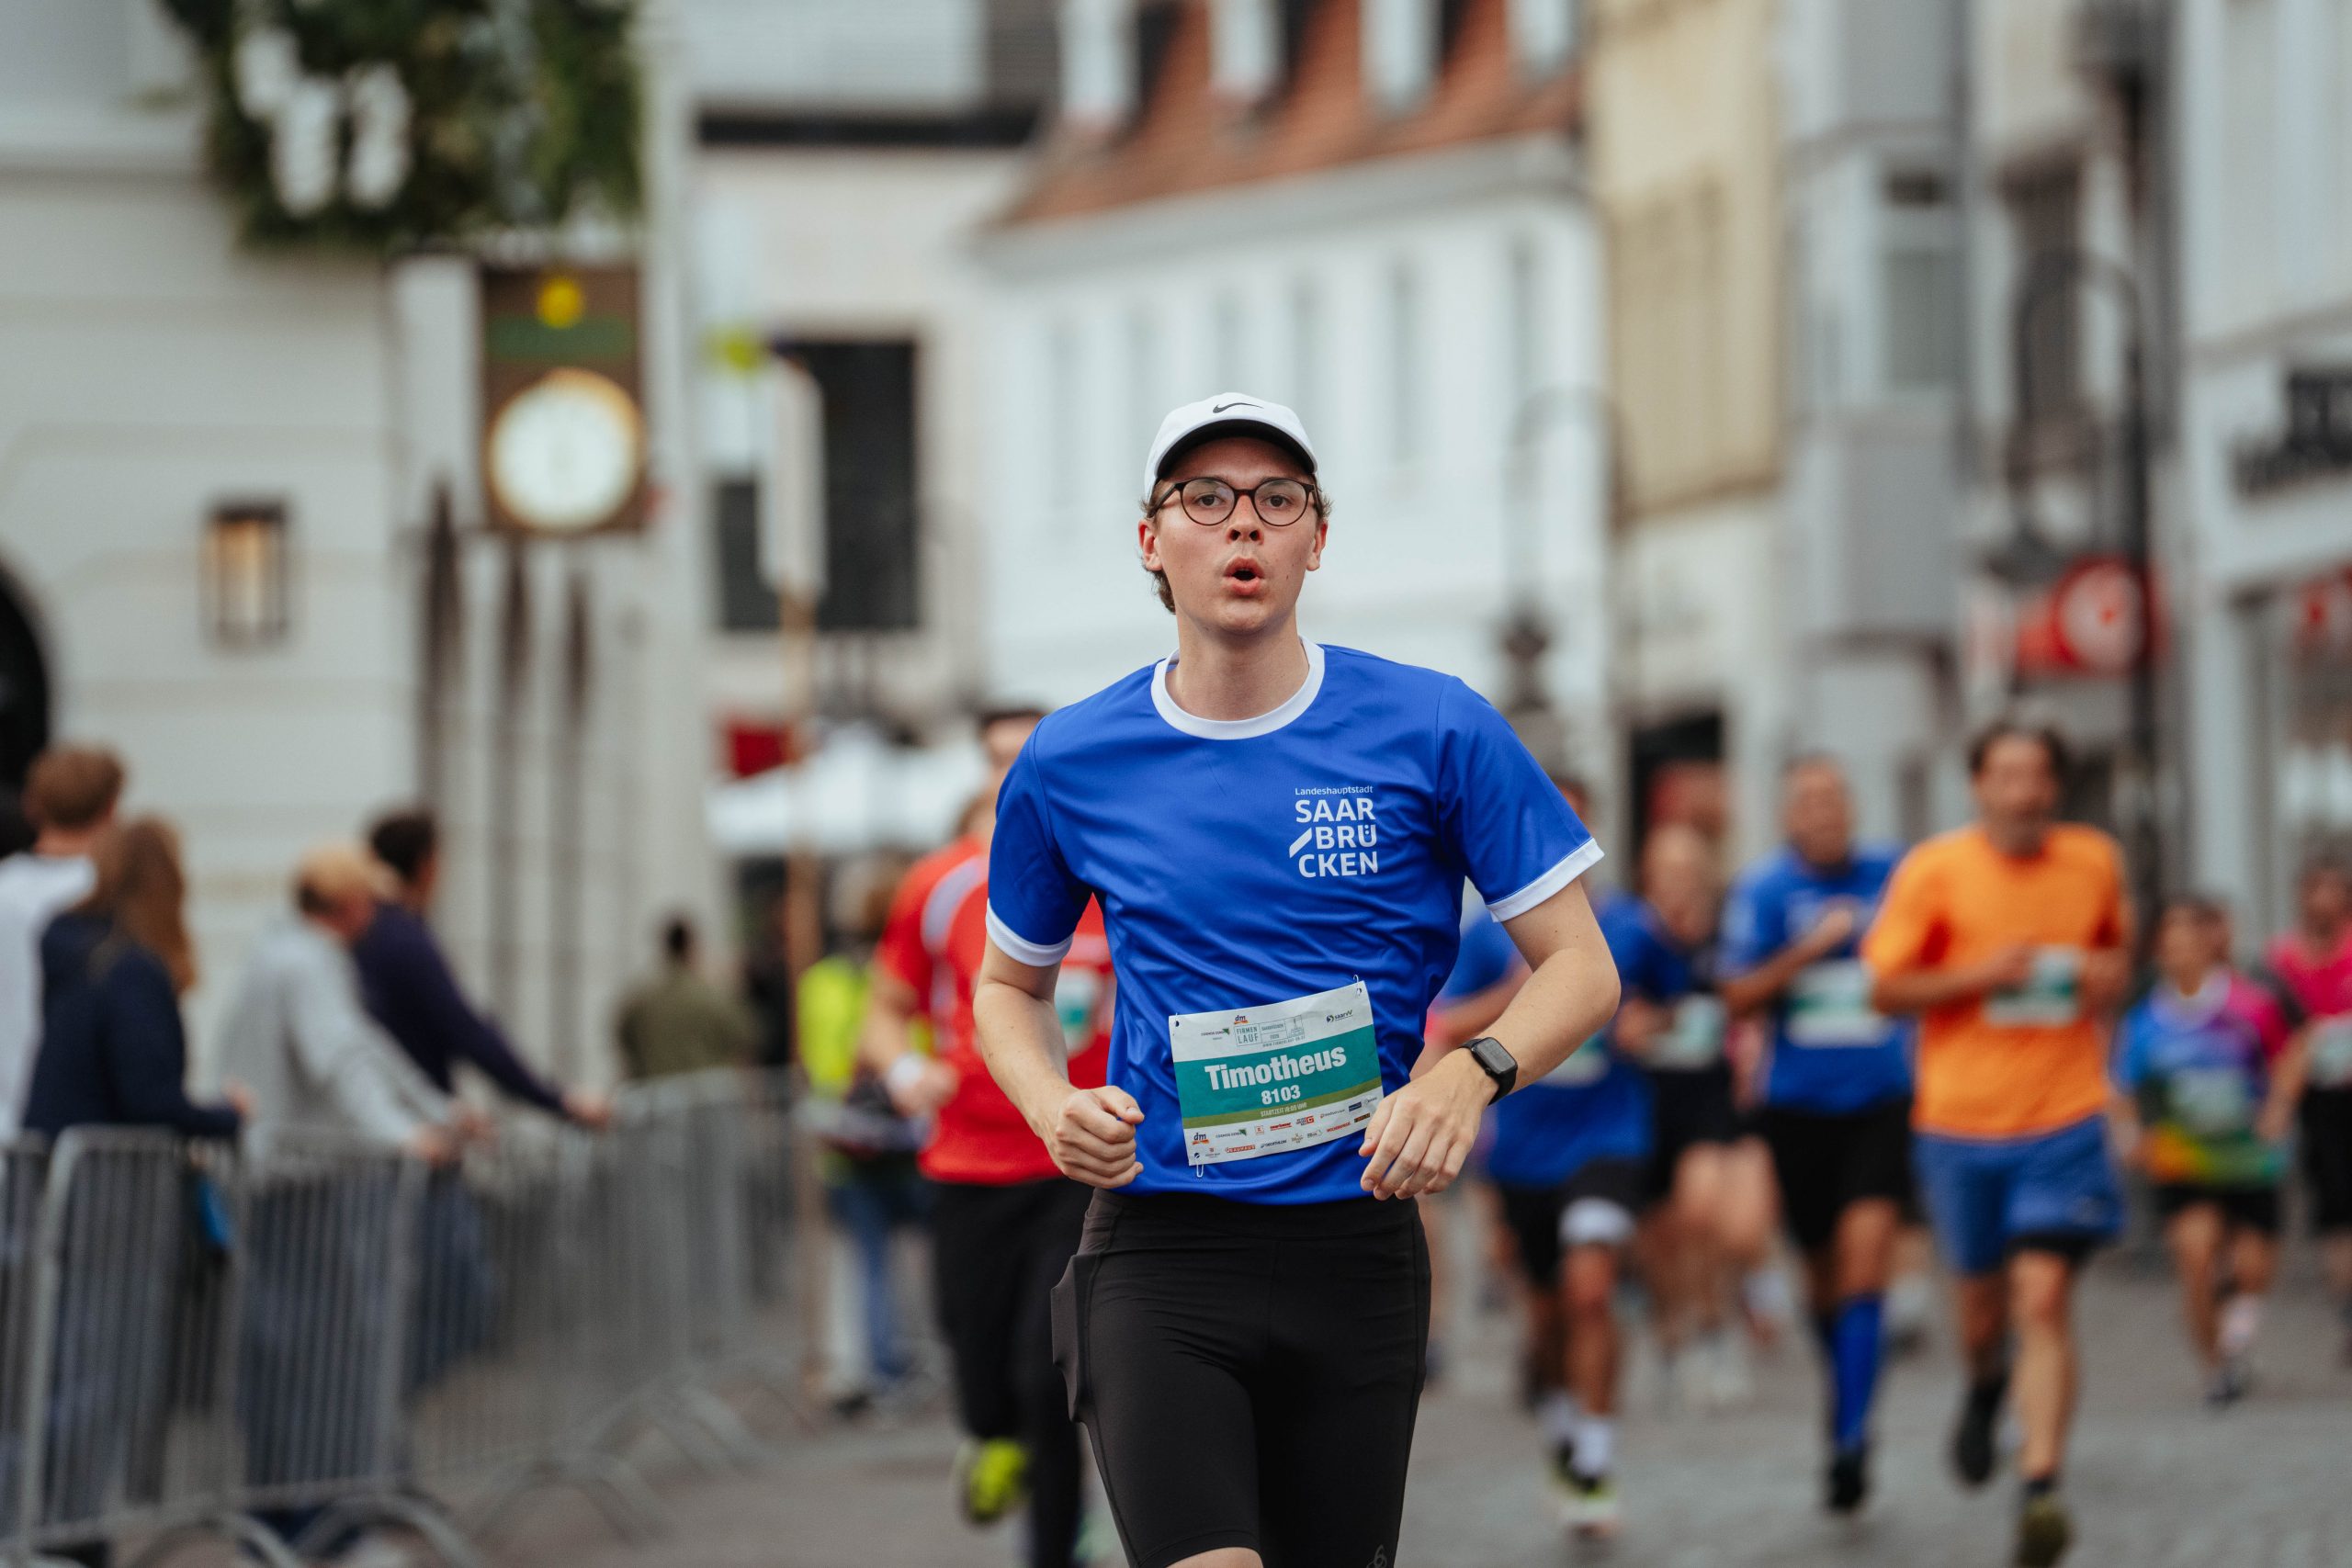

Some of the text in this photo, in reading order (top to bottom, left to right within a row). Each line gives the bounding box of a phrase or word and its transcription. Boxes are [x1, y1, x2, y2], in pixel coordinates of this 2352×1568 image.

[1295, 785, 1374, 795] Landeshauptstadt
[1295, 797, 1376, 823] SAAR
[1298, 851, 1379, 878] CKEN
[1235, 1014, 1246, 1022] dm
[1237, 1026, 1258, 1034] FIRMEN
[1238, 1033, 1259, 1044] LAUF
[1204, 1046, 1347, 1090] Timotheus
[1261, 1084, 1302, 1105] 8103
[1193, 1132, 1207, 1141] dm
